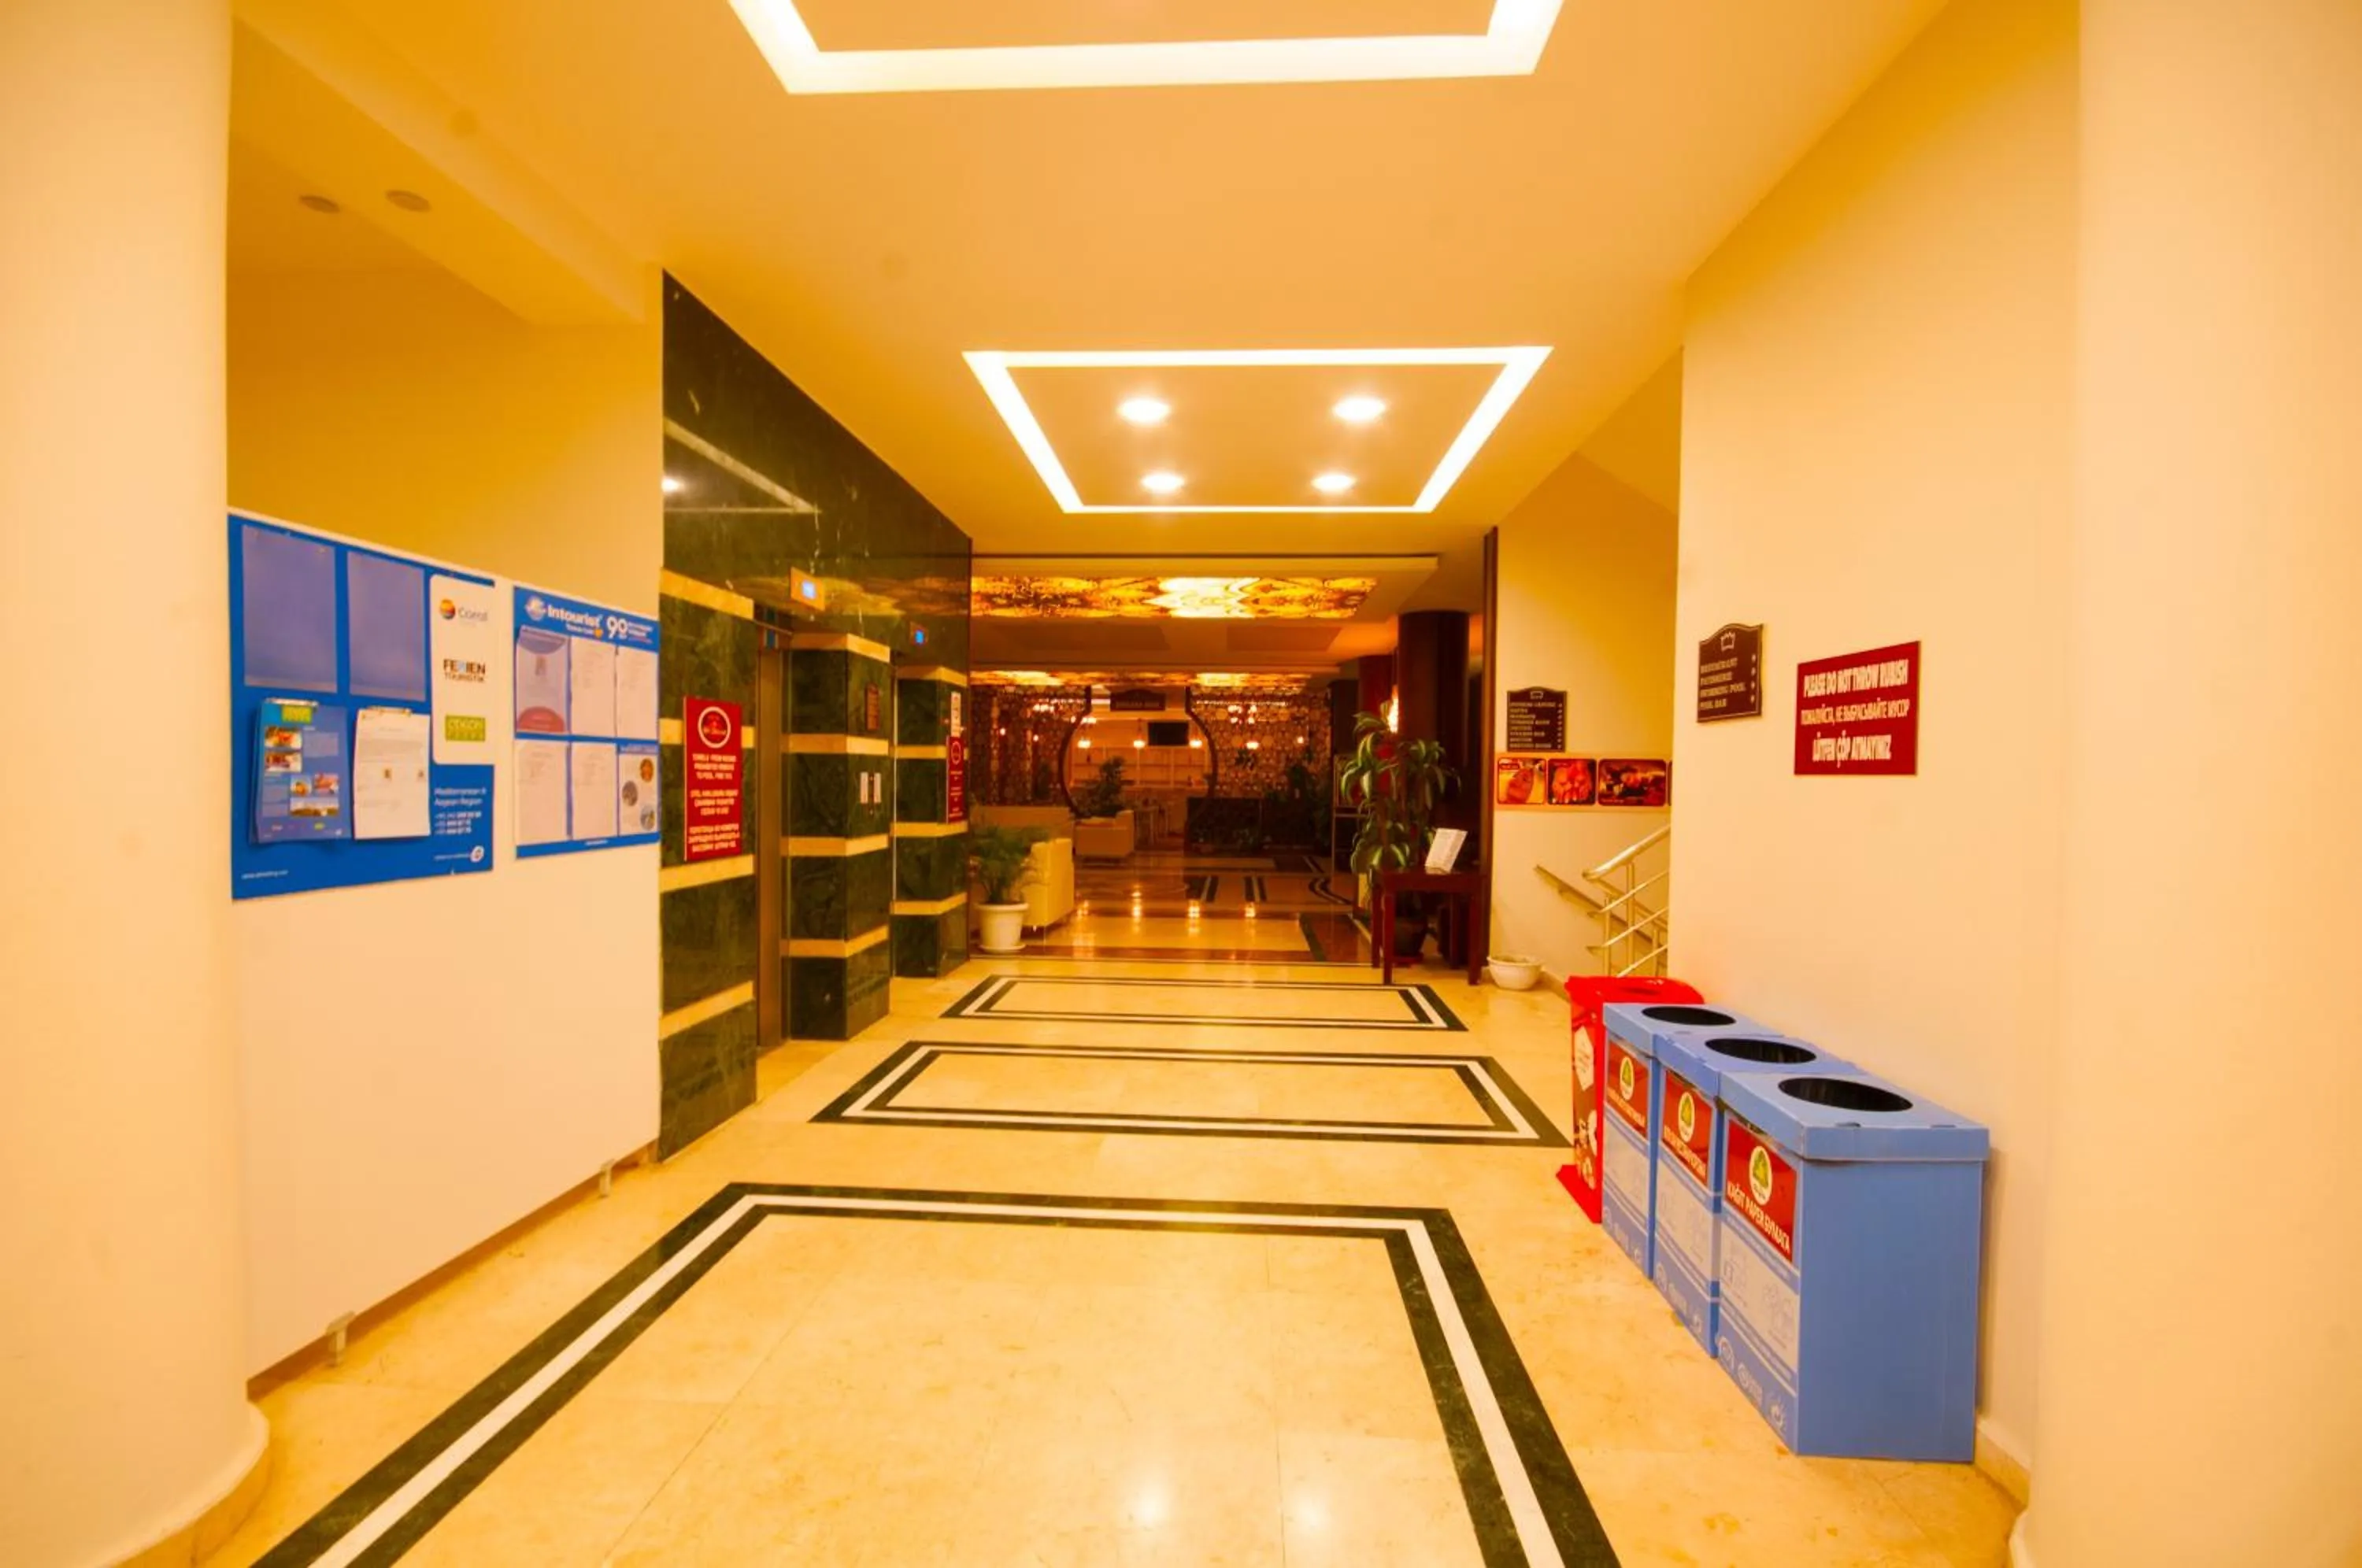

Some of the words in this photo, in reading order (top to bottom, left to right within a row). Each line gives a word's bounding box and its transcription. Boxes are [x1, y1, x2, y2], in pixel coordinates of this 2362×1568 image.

[547, 605, 600, 628] Intourist
[606, 615, 628, 638] 90
[1804, 673, 1826, 698] PLEASE
[1826, 671, 1837, 695] DO
[1837, 668, 1852, 693] NOT
[1852, 664, 1879, 691] THROW
[1836, 730, 1851, 768] ÇÖP
[1746, 1195, 1764, 1226] PAPER
